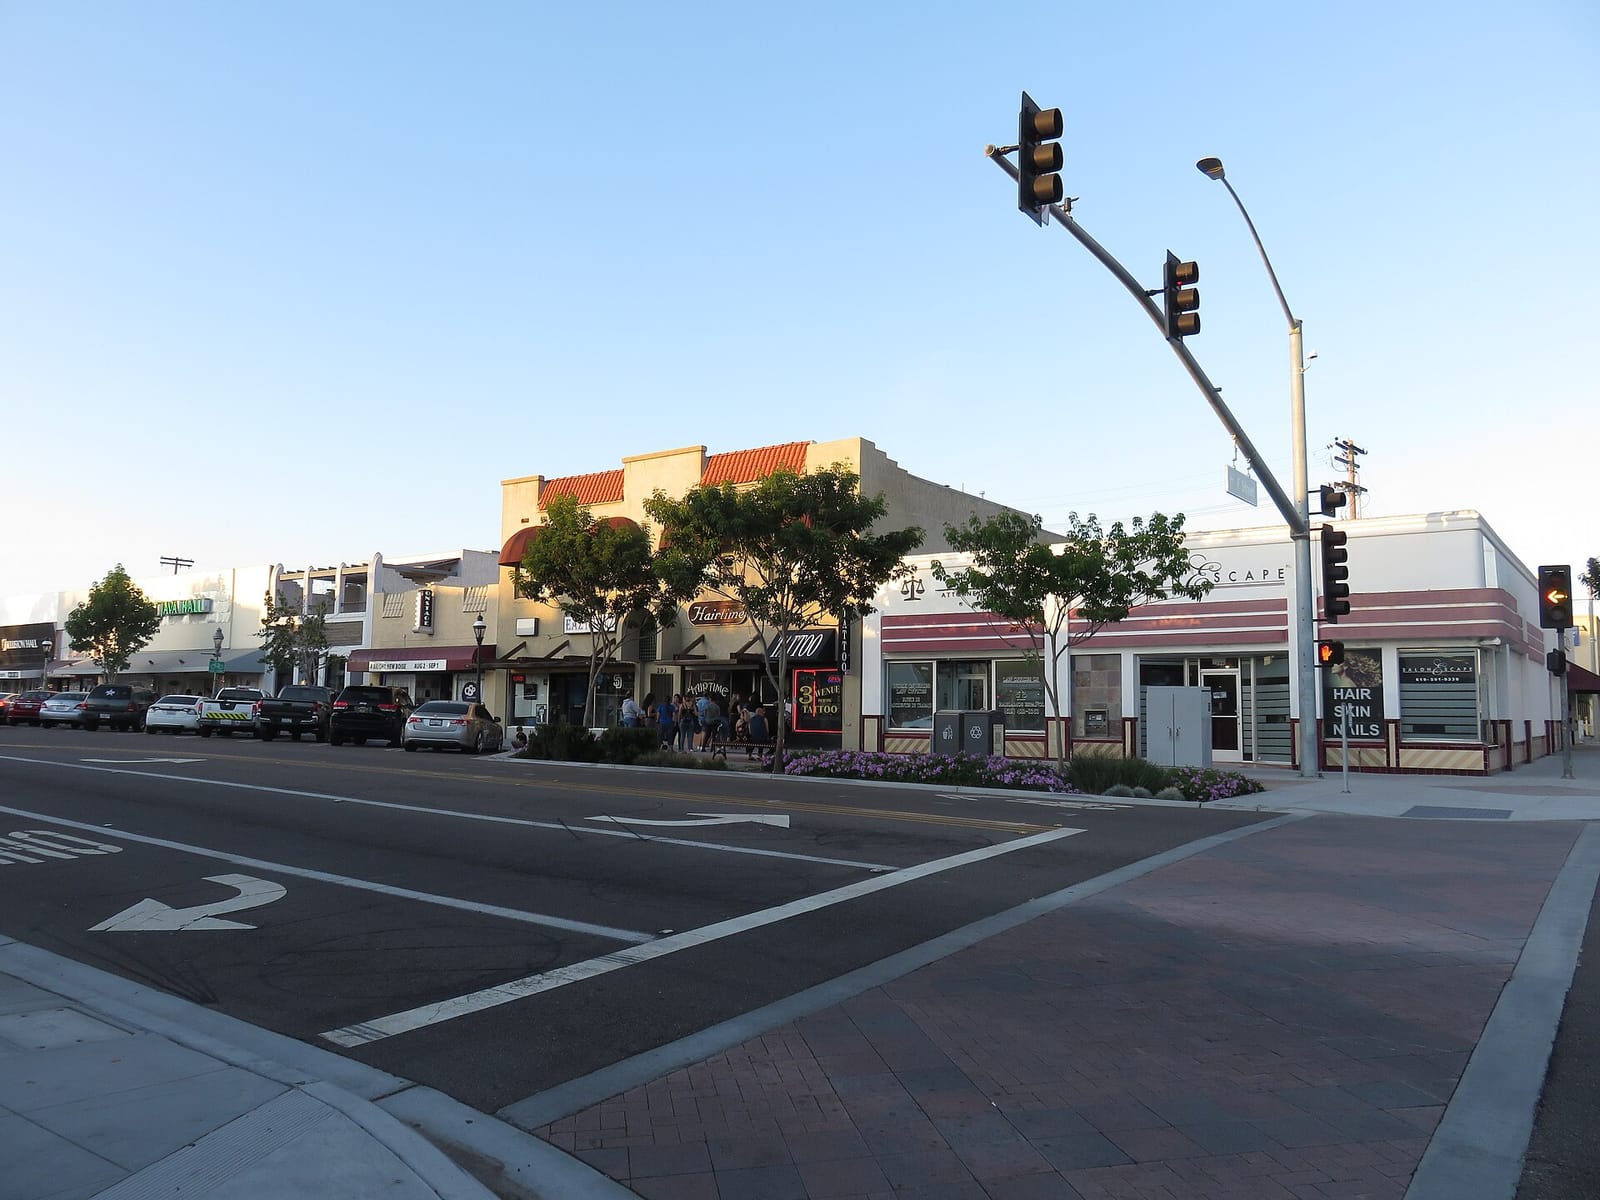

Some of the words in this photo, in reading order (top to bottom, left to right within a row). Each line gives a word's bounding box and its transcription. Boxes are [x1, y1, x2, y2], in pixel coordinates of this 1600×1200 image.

[182, 598, 202, 614] HALL
[691, 606, 744, 621] Hairtime
[798, 685, 813, 705] 3
[813, 685, 840, 698] VENUE
[1333, 688, 1372, 700] HAIR
[1333, 705, 1371, 718] SKIN
[1333, 723, 1380, 736] NILS
